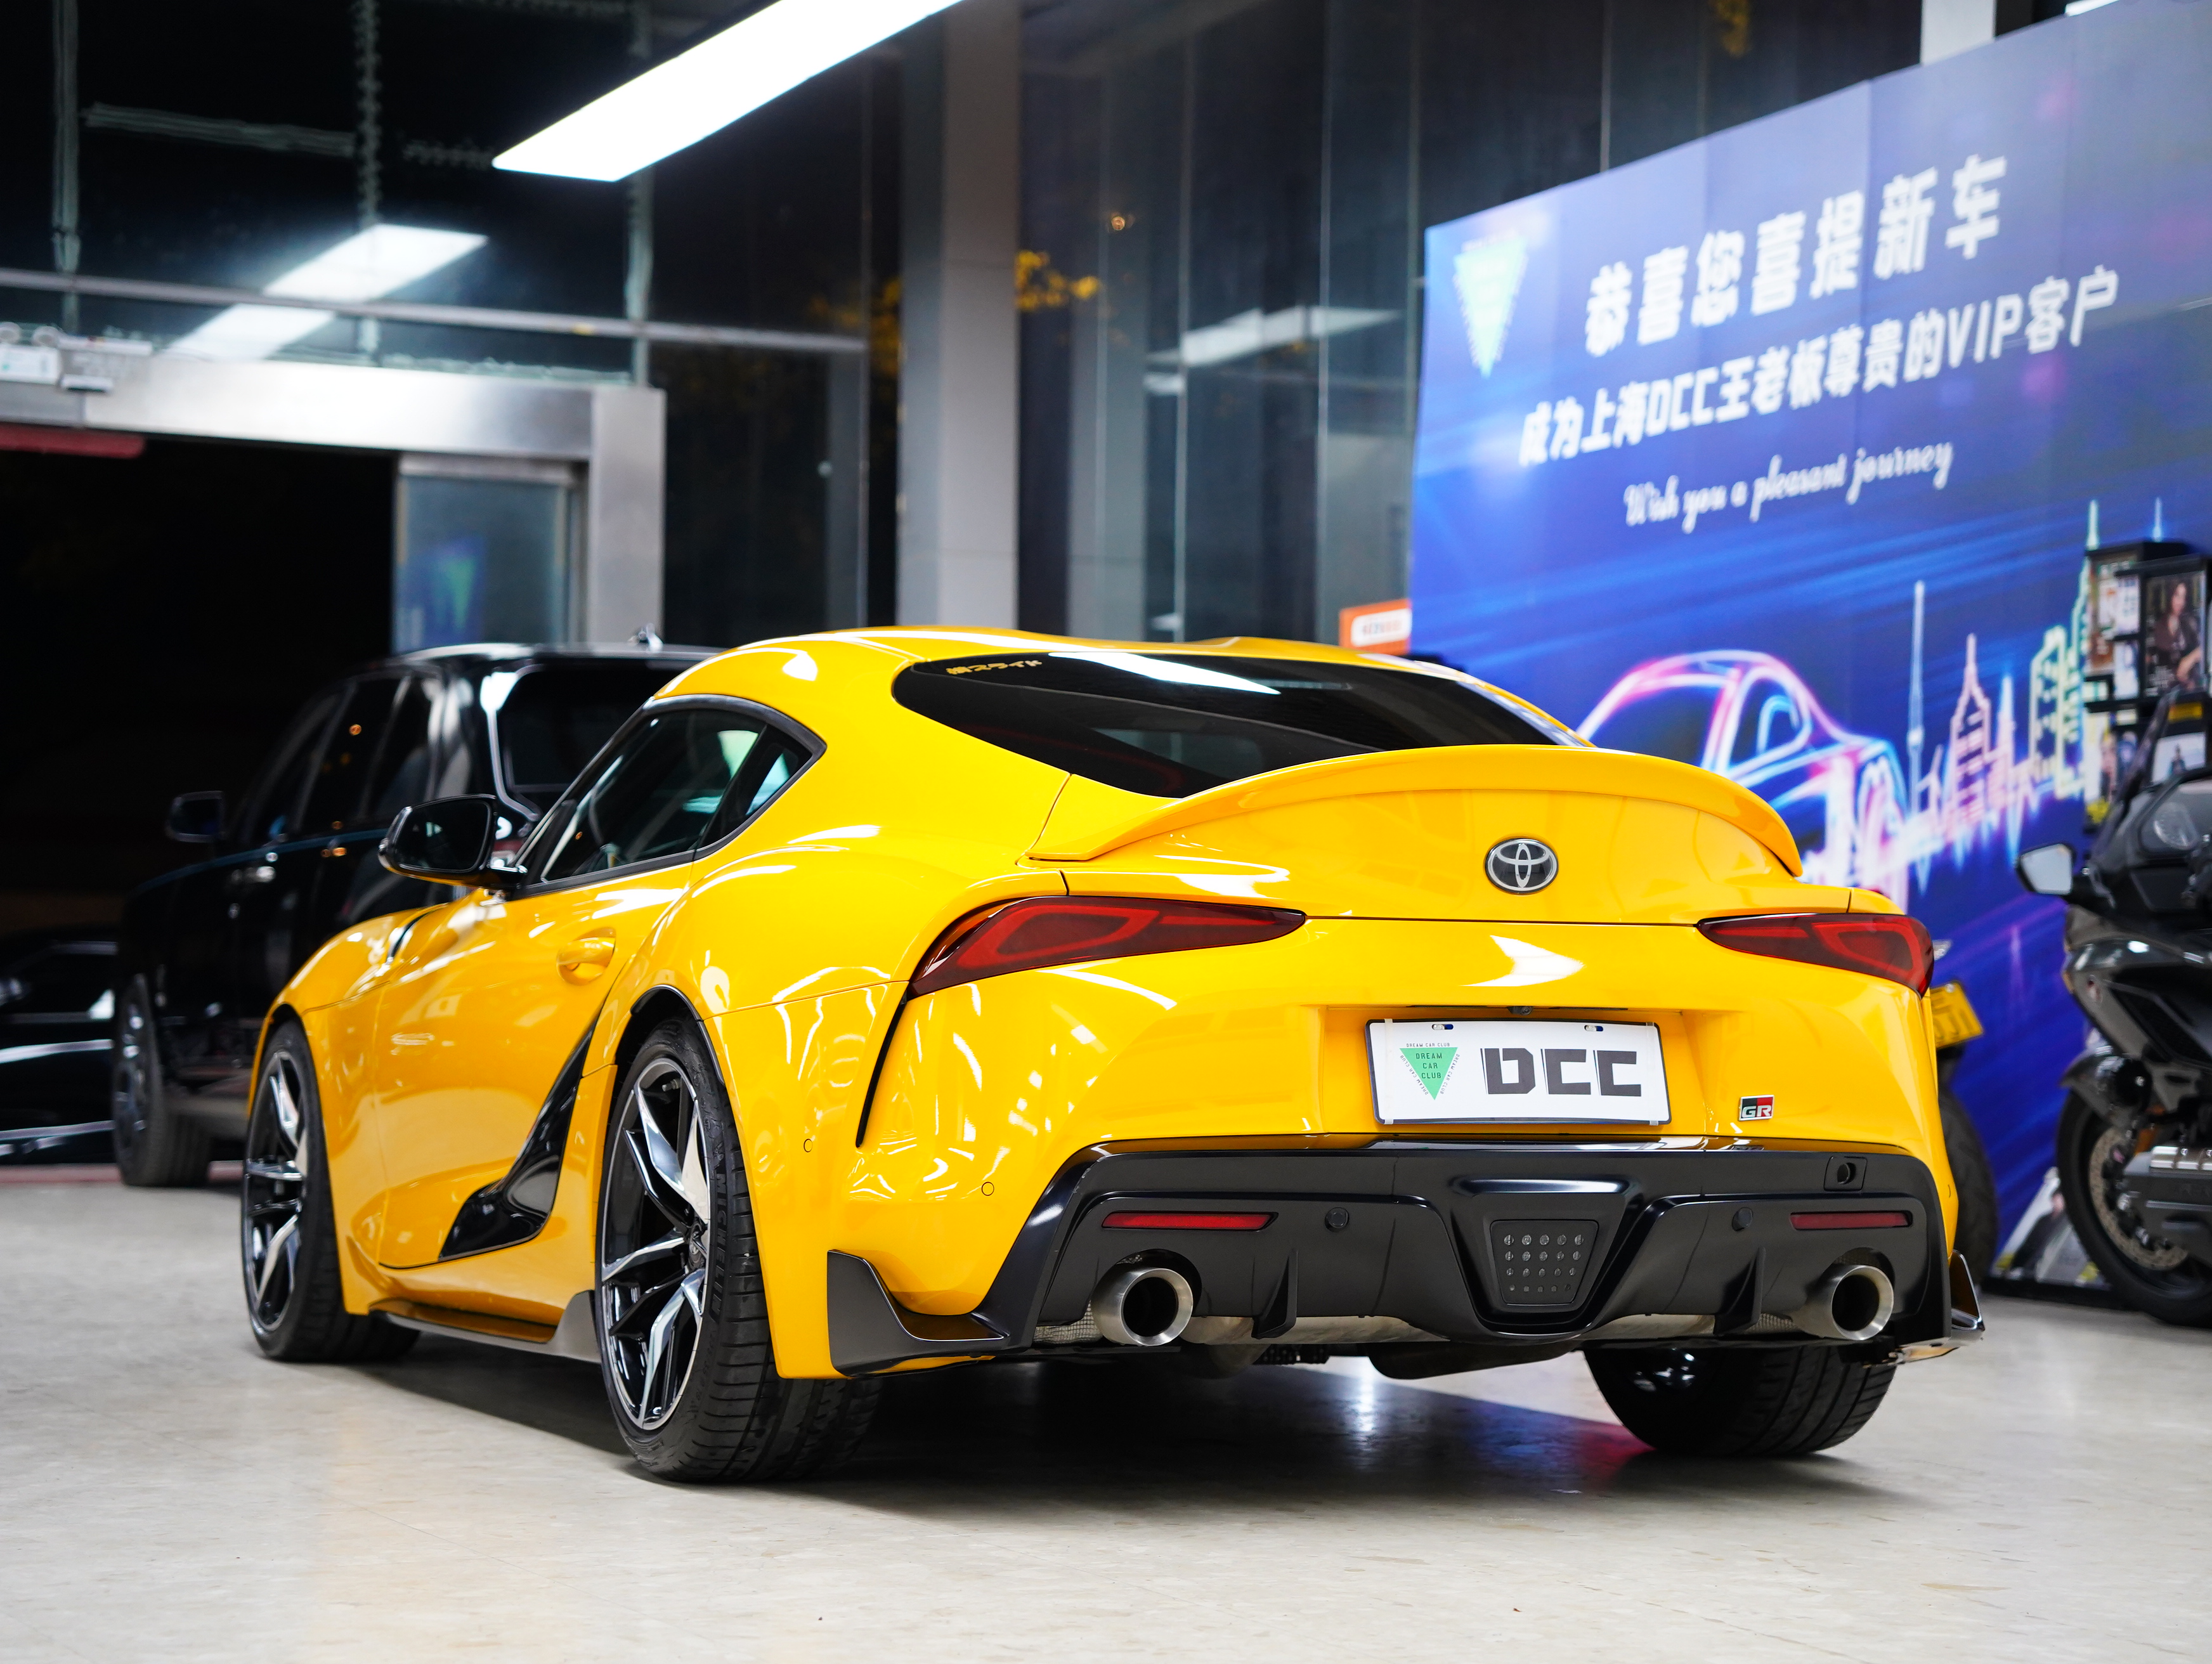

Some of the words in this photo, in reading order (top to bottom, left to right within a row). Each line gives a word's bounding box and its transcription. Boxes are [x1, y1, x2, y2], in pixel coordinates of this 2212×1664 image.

[1585, 153, 2007, 357] 恭喜您喜提新车
[1623, 474, 1679, 526] Wish
[1681, 485, 1727, 534] you
[1730, 481, 1748, 507] a
[1748, 453, 1848, 523] pleasant
[1845, 441, 1953, 505] journey
[1480, 1048, 1642, 1098] DCC
[1741, 1105, 1772, 1118] GR
